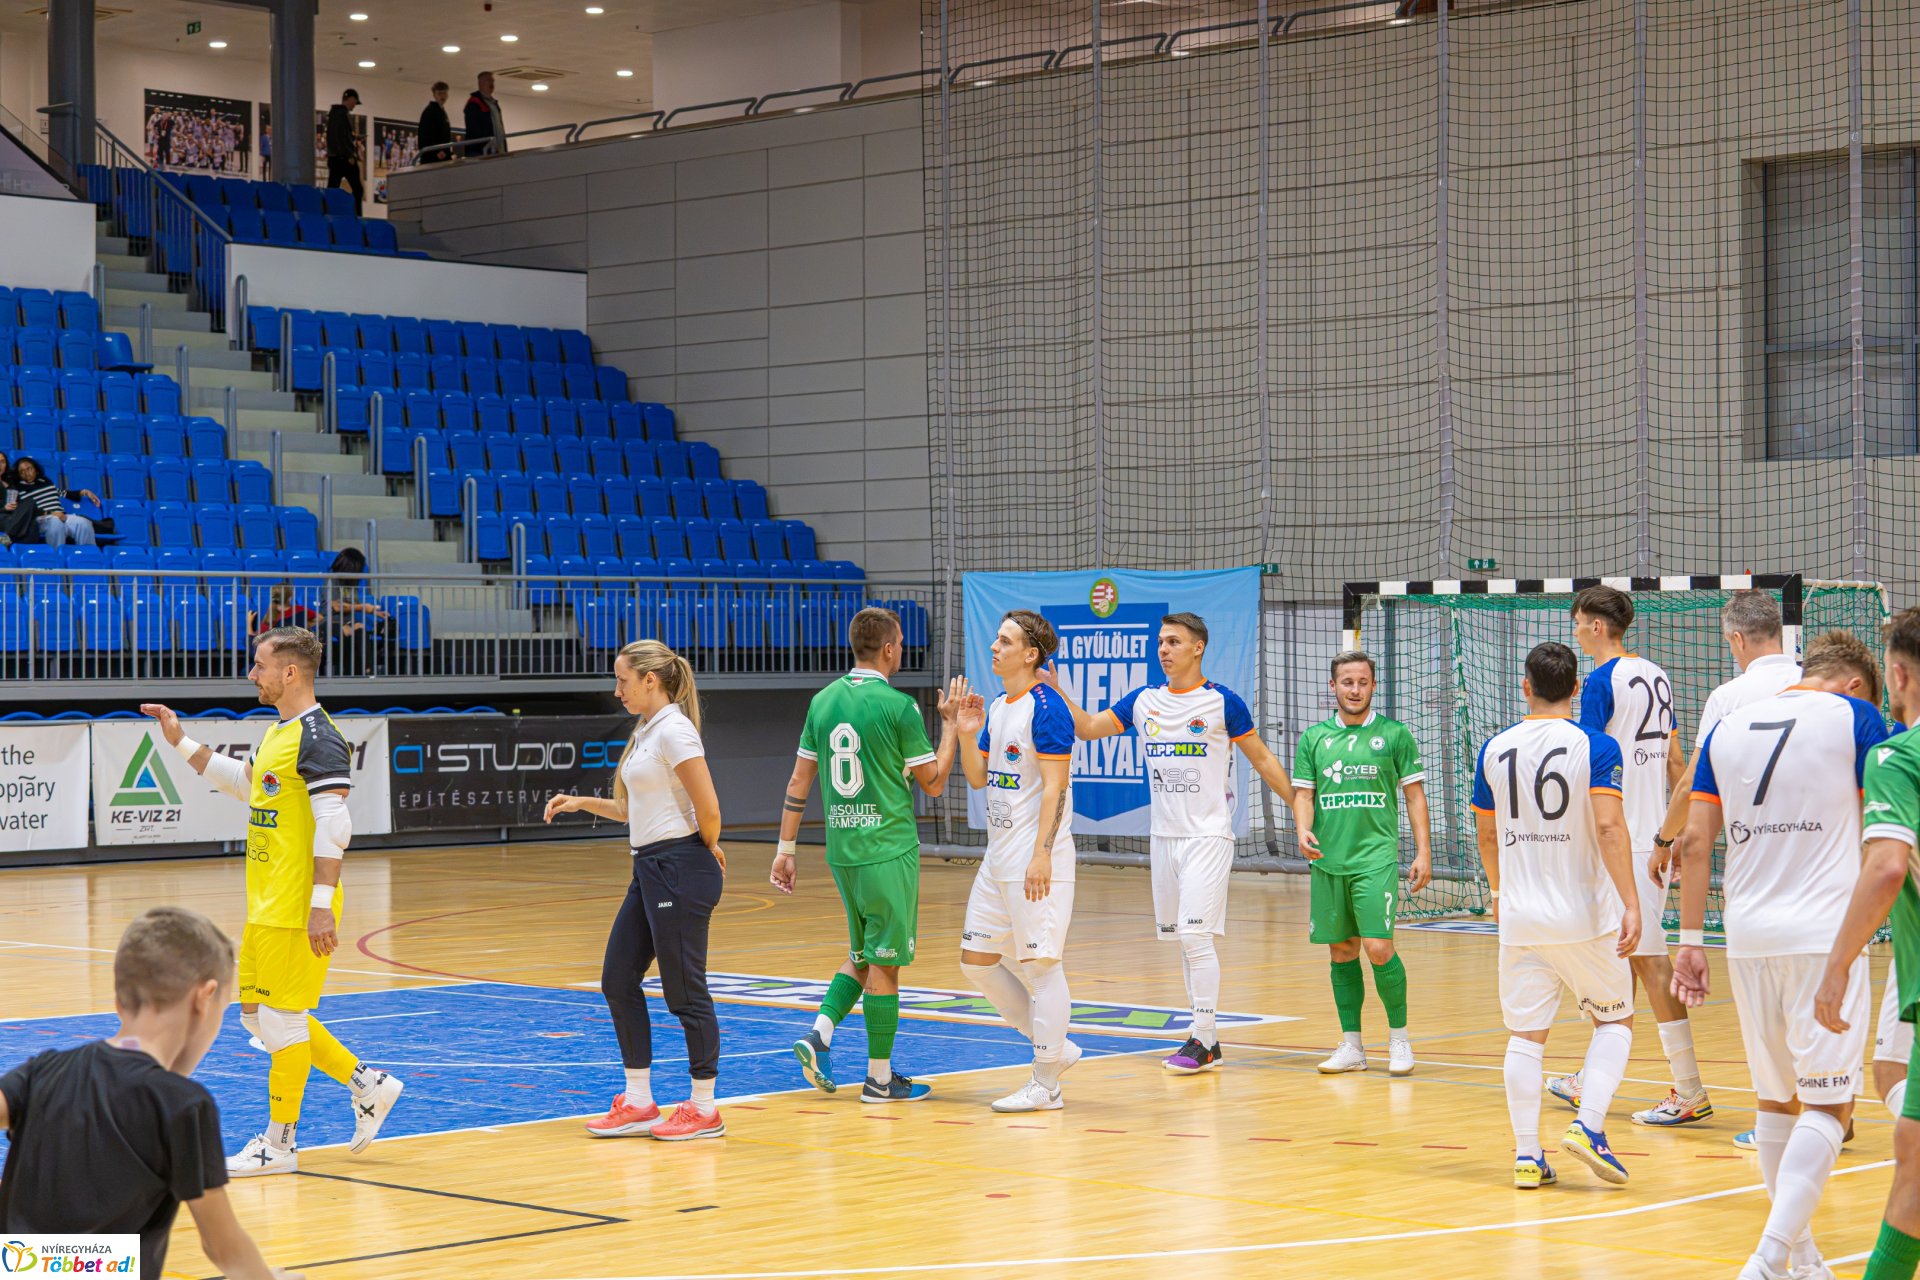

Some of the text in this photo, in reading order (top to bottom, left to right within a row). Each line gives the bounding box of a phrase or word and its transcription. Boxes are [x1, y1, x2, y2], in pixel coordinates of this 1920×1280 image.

[1058, 631, 1149, 659] A GYŰLÖLET
[1628, 675, 1673, 741] 28
[1347, 735, 1358, 752] 7
[1, 744, 35, 765] the
[437, 742, 576, 772] STUDIO
[829, 722, 865, 798] 8
[1749, 718, 1797, 806] 7
[1344, 765, 1378, 775] CYEB
[1153, 784, 1201, 793] STUDIO
[1498, 747, 1570, 821] 16
[111, 809, 182, 824] KE-VIZ 21
[830, 804, 878, 816] ABSOLUTE
[828, 816, 882, 828] TEAMSPORT
[1384, 892, 1393, 915] 7
[1612, 1001, 1626, 1012] FM
[1833, 1075, 1850, 1087] FM
